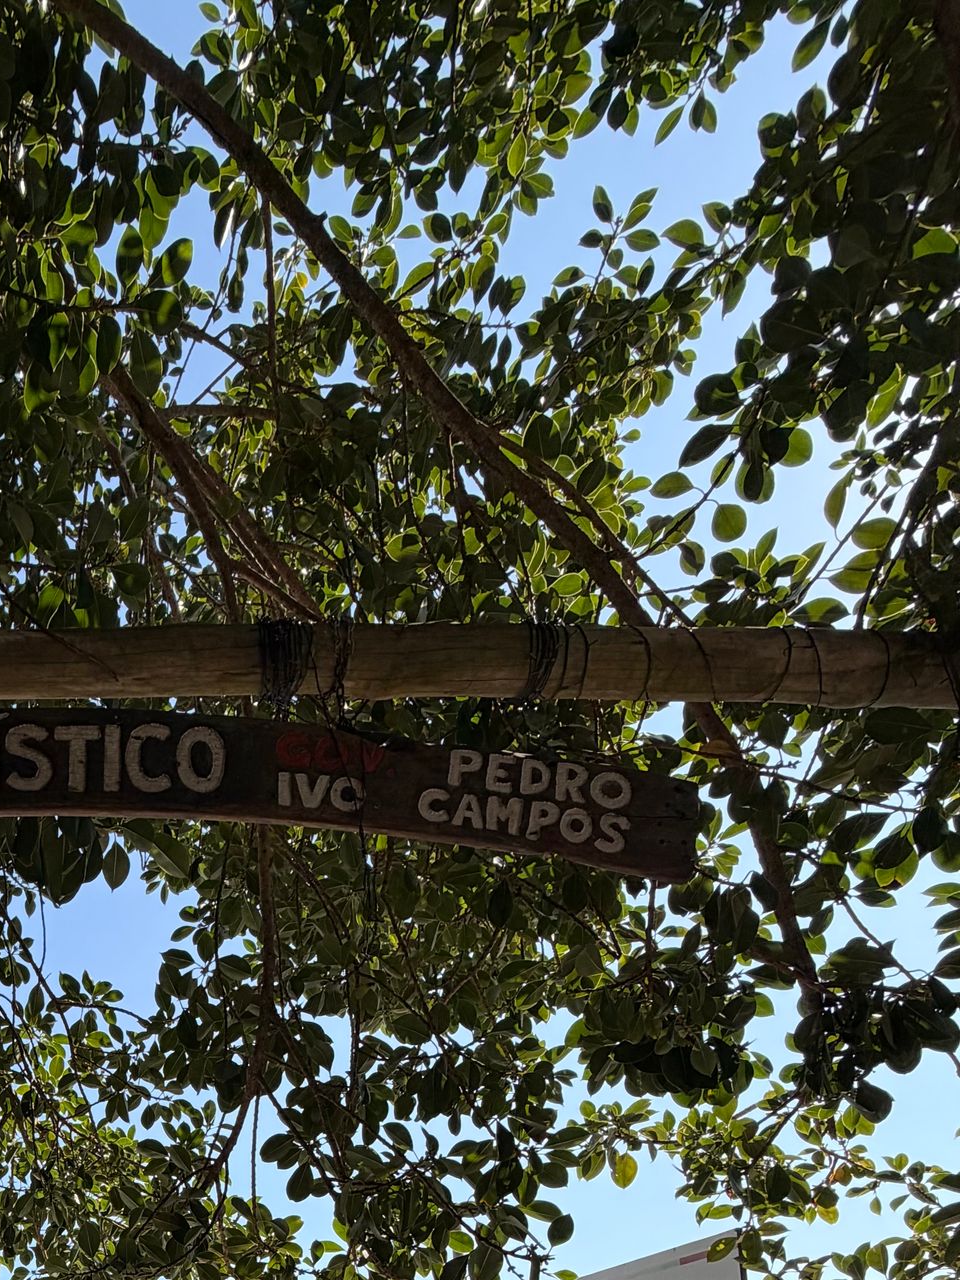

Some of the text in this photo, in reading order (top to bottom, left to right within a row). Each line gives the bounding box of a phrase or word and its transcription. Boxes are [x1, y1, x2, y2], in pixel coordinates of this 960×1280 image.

[277, 771, 367, 813] IVO
[448, 748, 633, 810] PEDRO
[418, 787, 632, 854] CAMPOS
